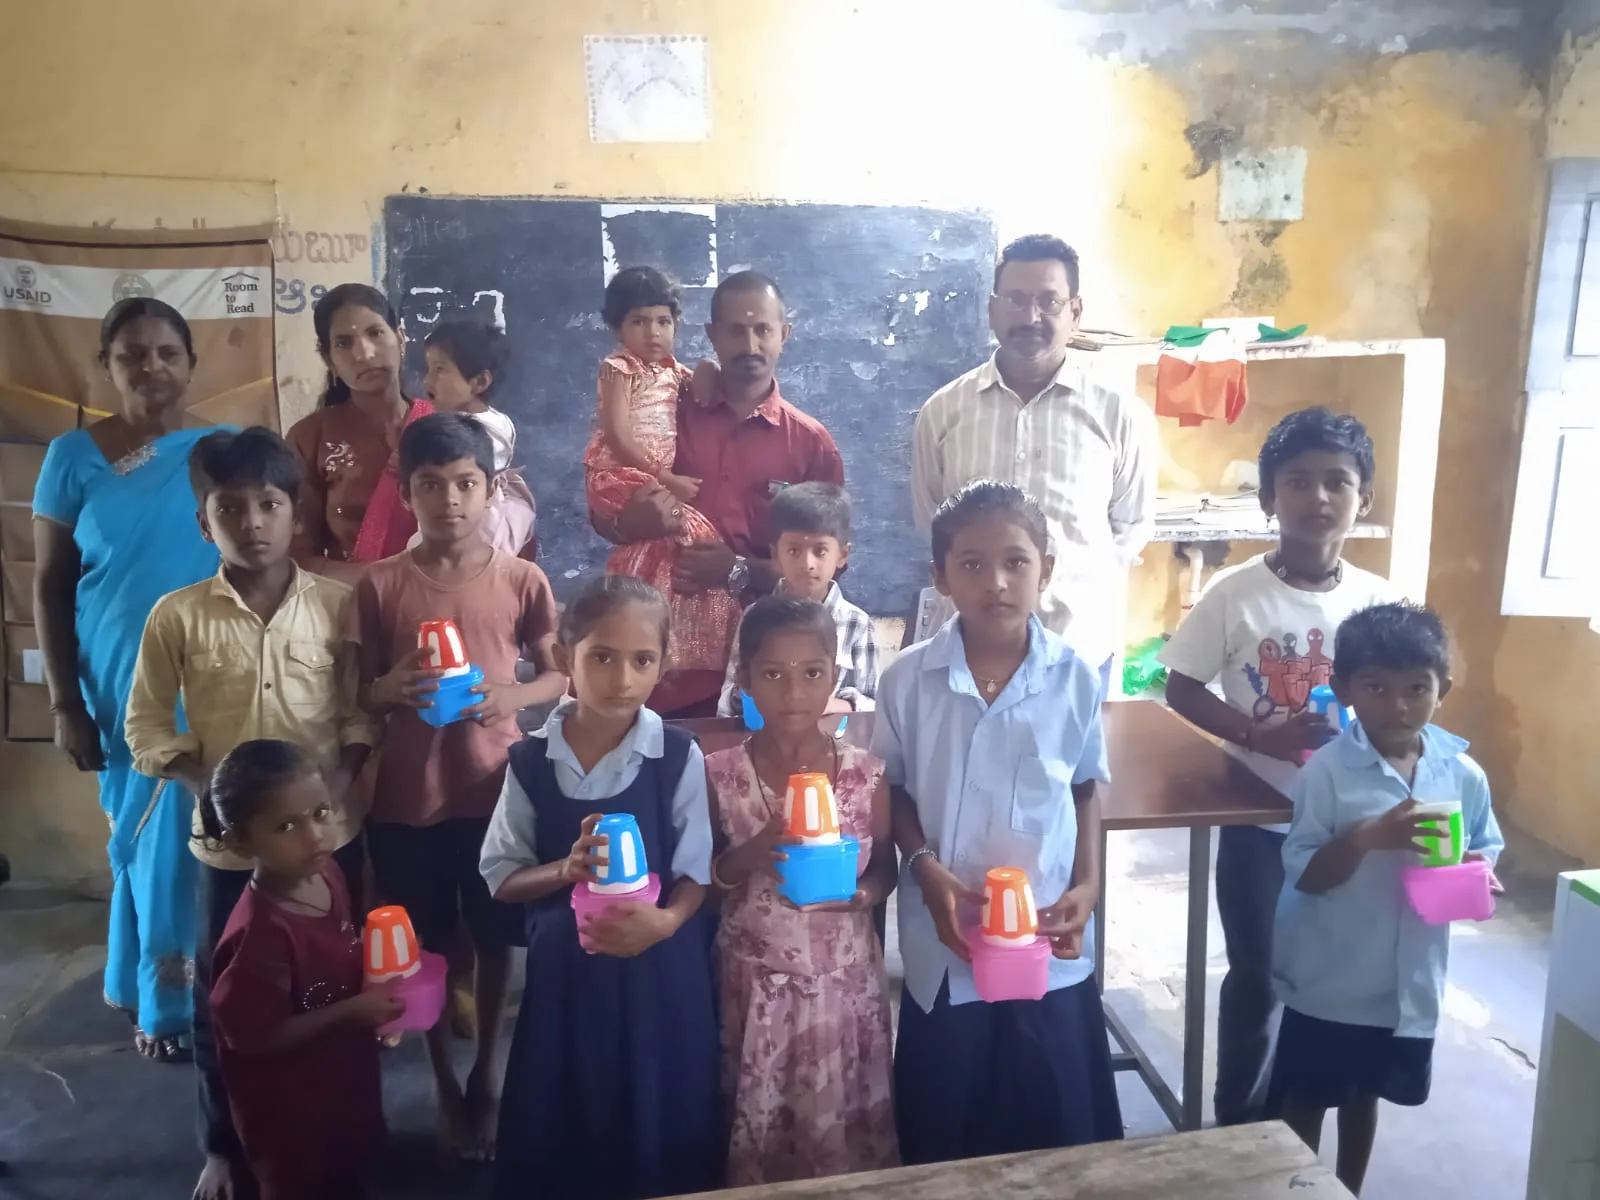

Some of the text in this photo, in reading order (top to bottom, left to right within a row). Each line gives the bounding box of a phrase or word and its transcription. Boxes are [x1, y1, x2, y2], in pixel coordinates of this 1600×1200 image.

[224, 282, 258, 292] Room
[4, 286, 52, 303] USAID
[225, 294, 236, 303] to
[226, 302, 254, 314] Read
